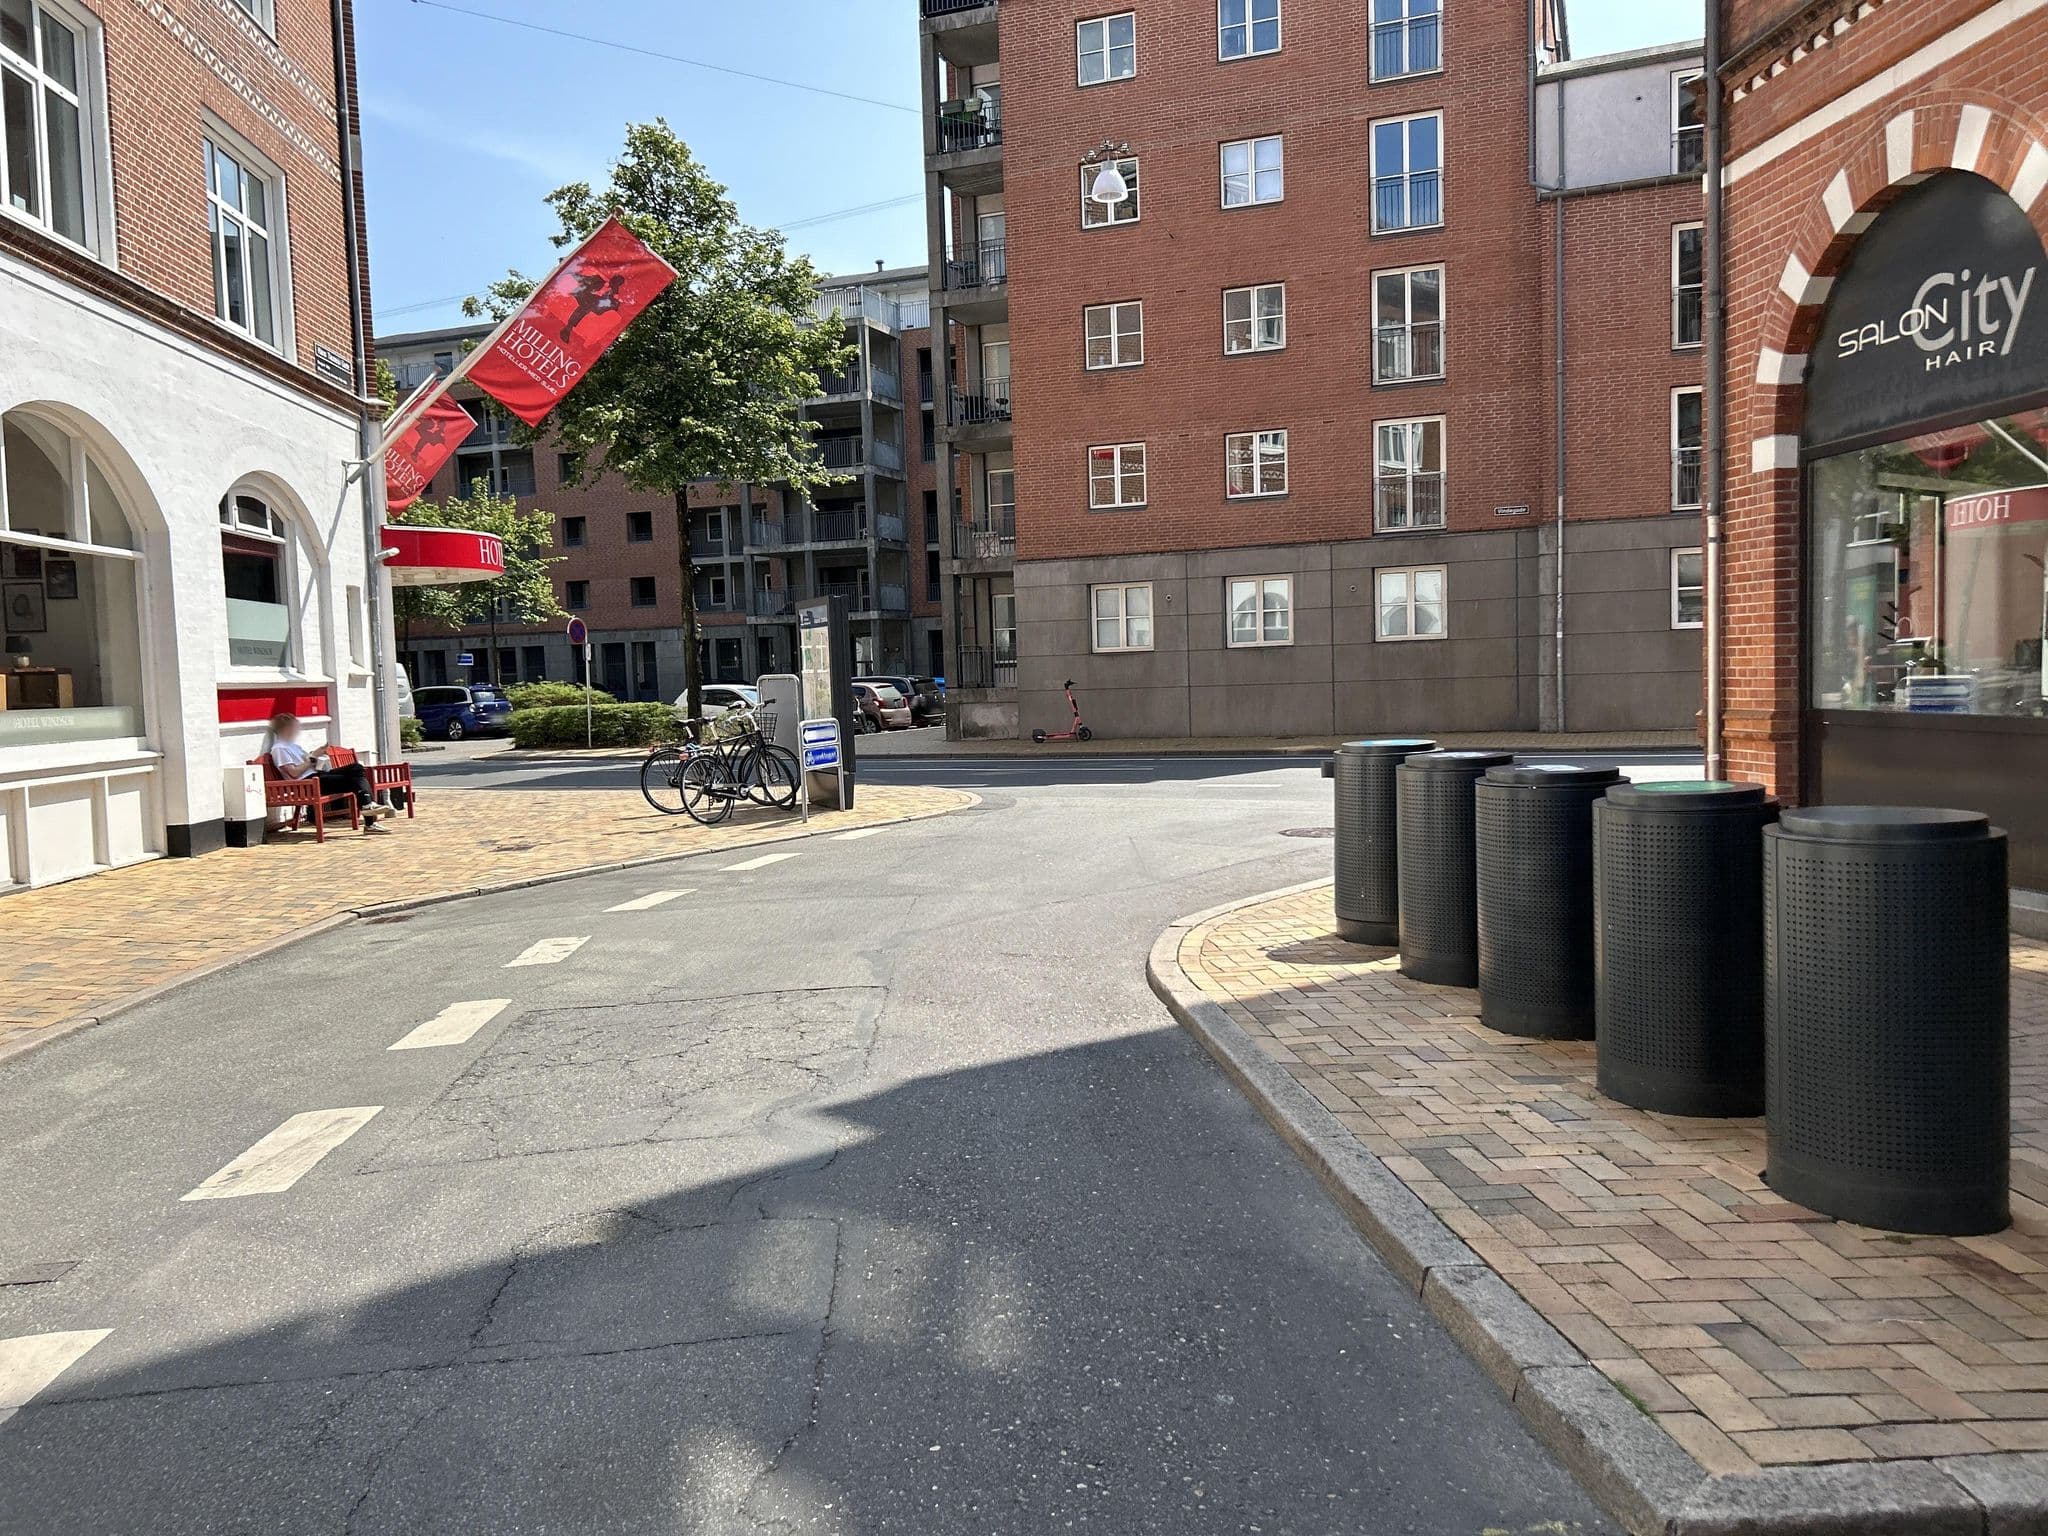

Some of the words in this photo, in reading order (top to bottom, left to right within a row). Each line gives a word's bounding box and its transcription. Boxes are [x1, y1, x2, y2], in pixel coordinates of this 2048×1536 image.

[1838, 298, 1949, 358] SALON
[1910, 266, 2037, 356] City
[496, 344, 528, 372] HOTELLER
[503, 331, 570, 389] HOTELS
[513, 319, 582, 377] MILLING
[1925, 339, 1997, 372] HAIR
[384, 459, 418, 494] OTELS
[15, 717, 40, 729] HOTEL
